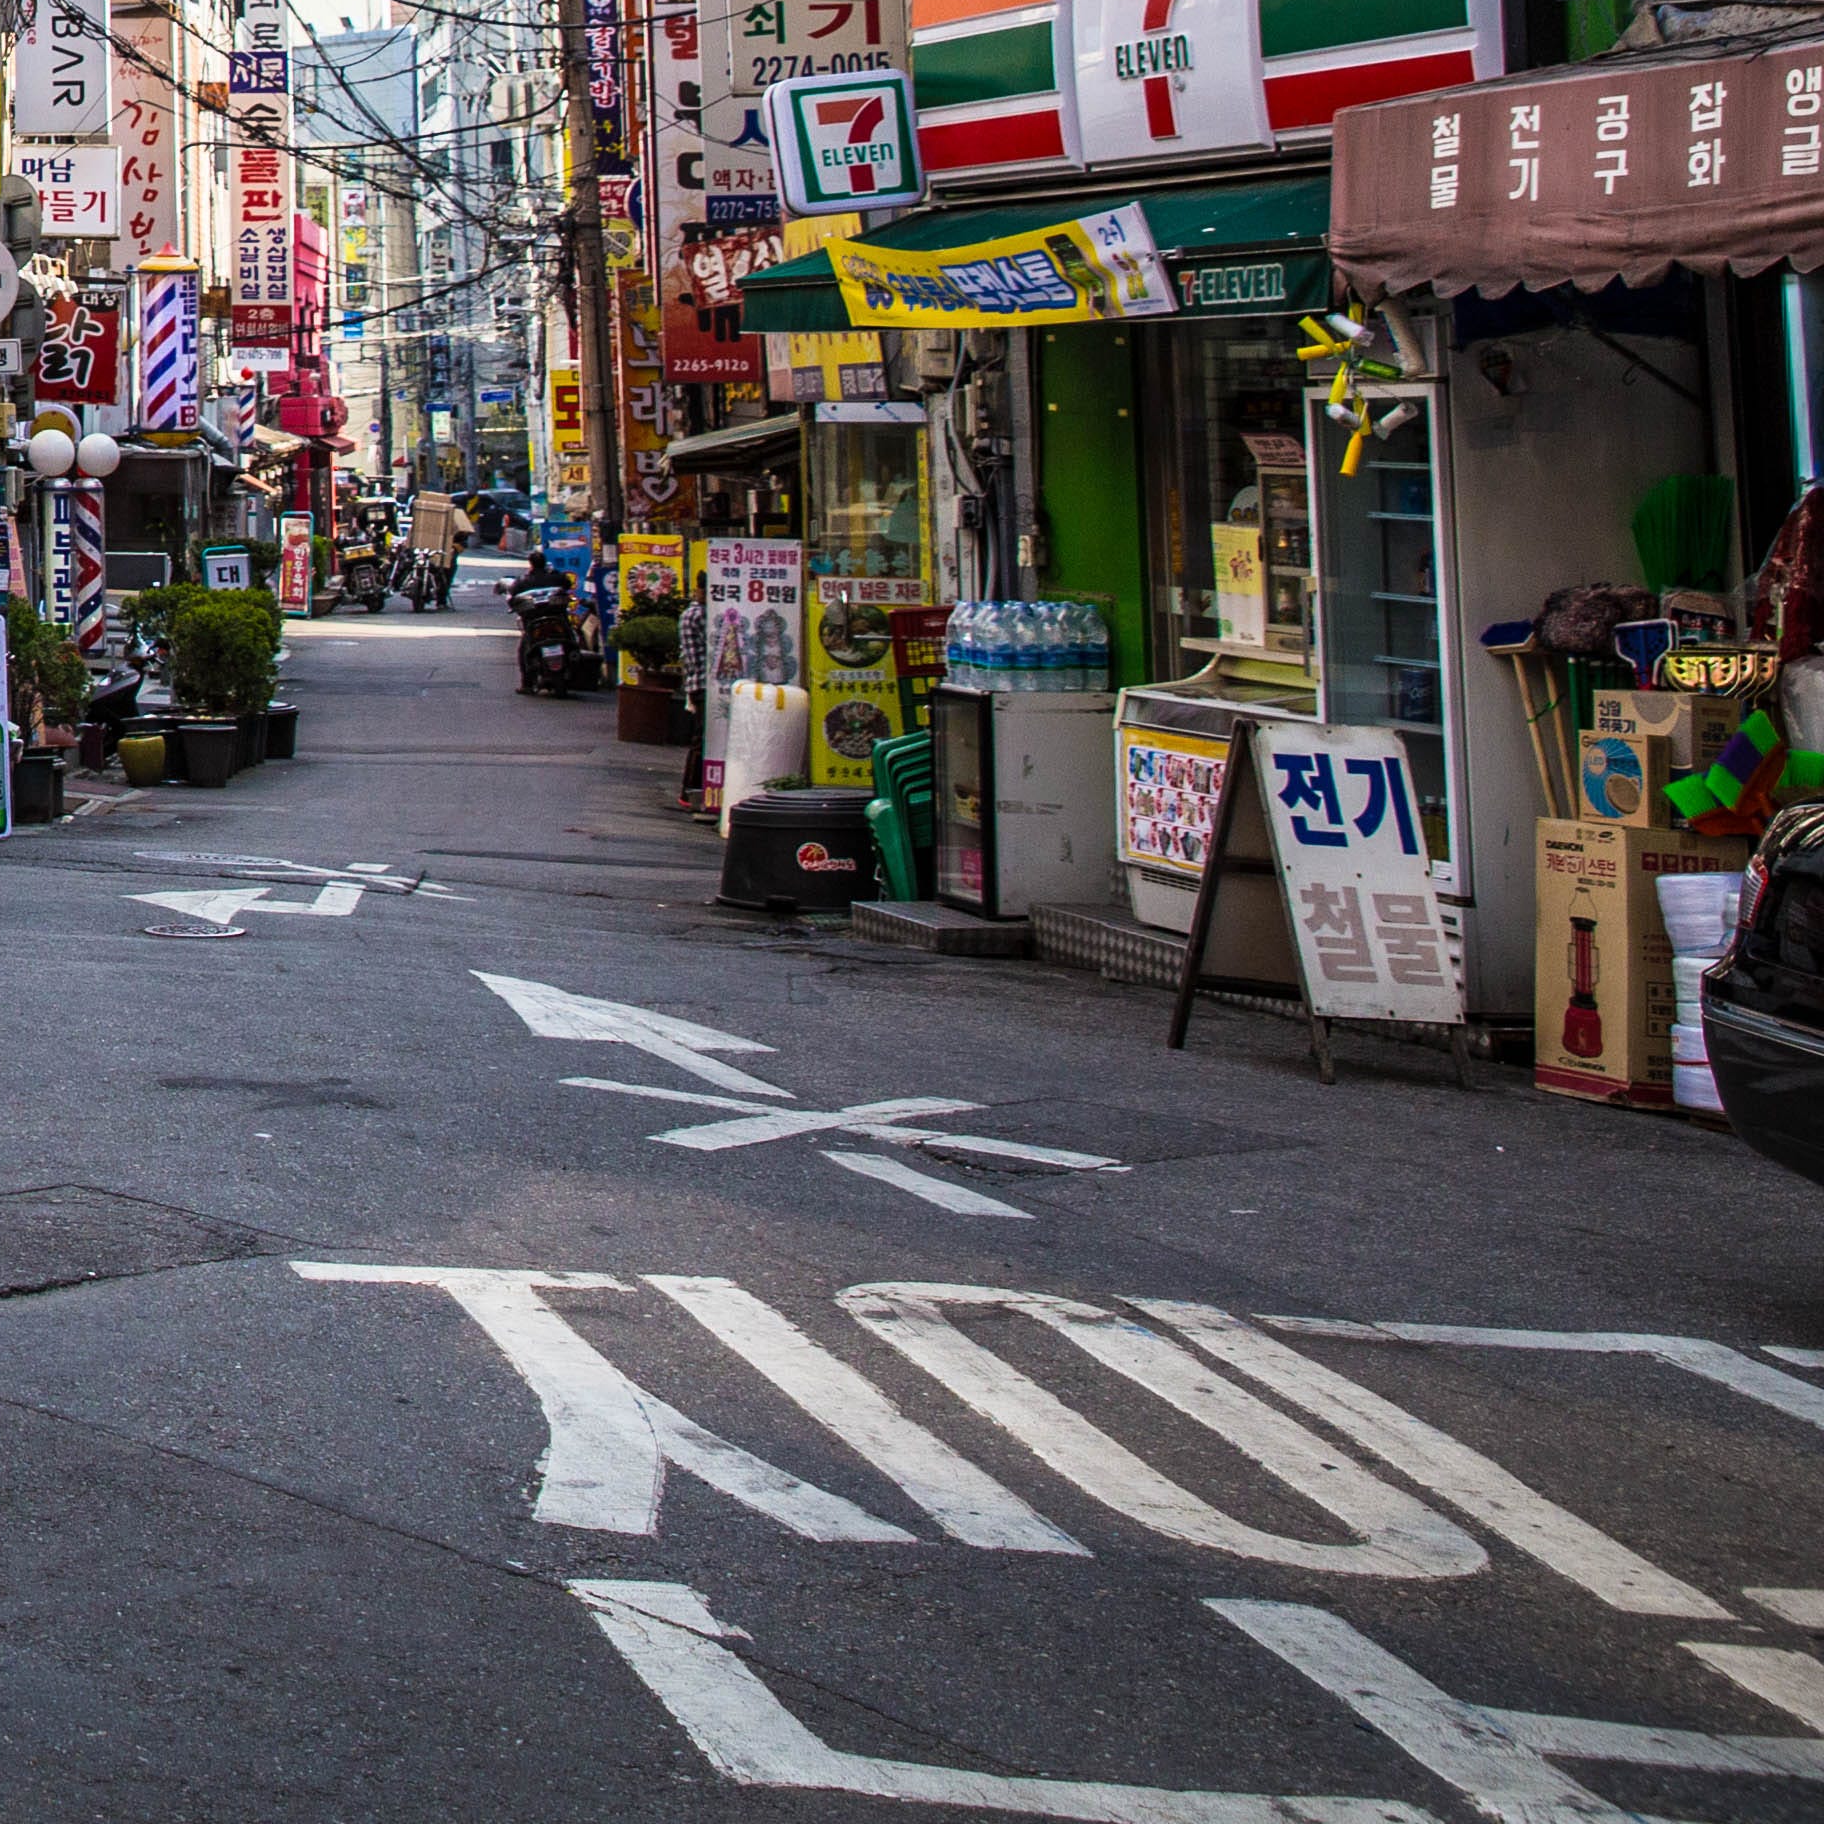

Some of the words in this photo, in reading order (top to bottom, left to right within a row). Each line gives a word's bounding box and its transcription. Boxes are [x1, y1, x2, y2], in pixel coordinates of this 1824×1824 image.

[1429, 114, 1461, 210] 철물
[1507, 104, 1542, 202] 전기
[1592, 95, 1631, 195] 공구
[1686, 81, 1726, 189] 잡화
[1271, 751, 1420, 857] 전기
[1300, 882, 1449, 988] 철물
